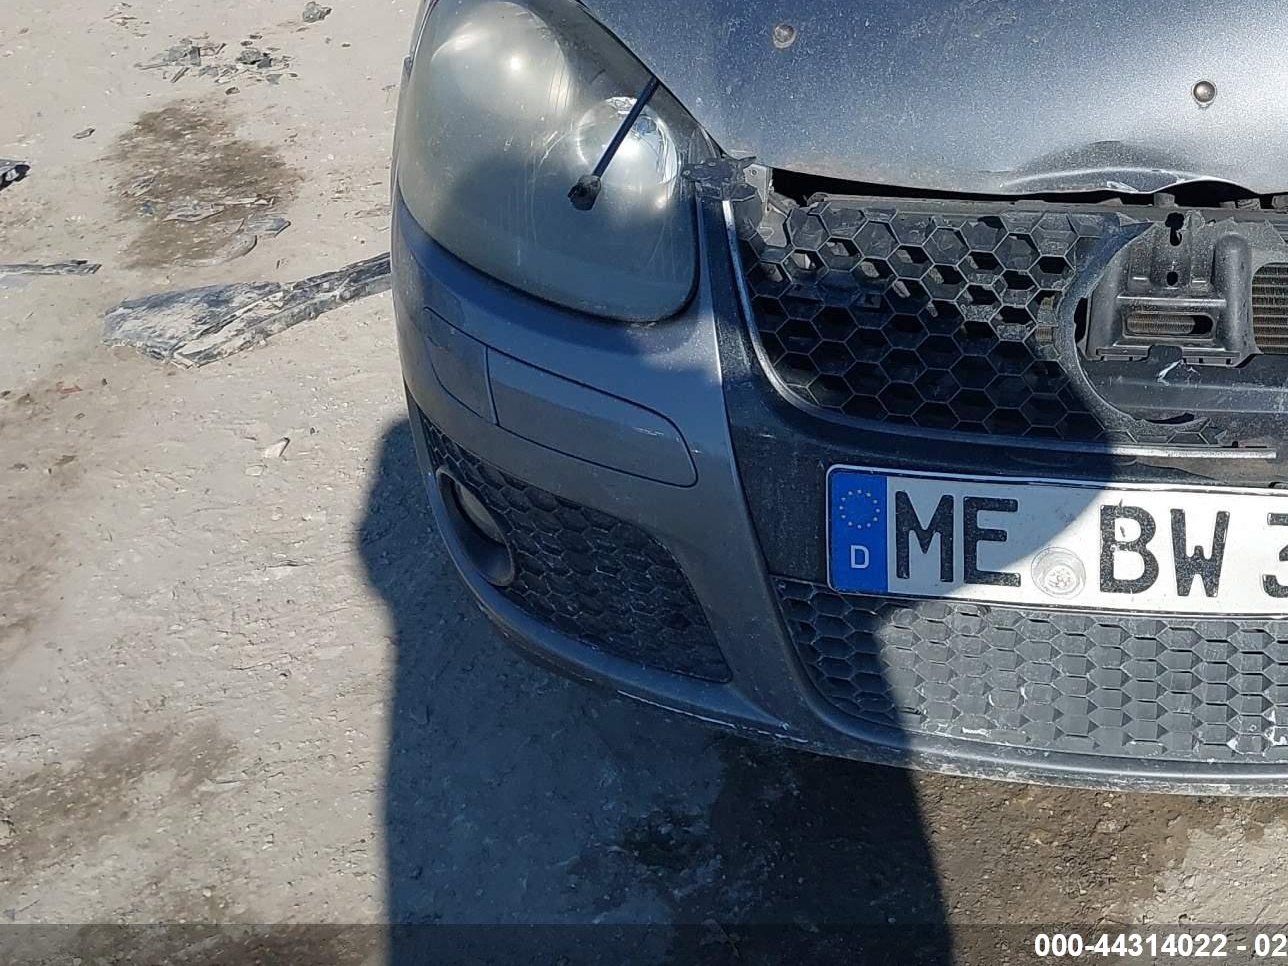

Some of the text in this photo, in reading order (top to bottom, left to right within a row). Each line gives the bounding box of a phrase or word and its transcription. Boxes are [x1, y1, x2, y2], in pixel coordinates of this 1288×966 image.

[849, 544, 870, 569] D
[894, 489, 1022, 587] ME
[1100, 503, 1230, 598] BW
